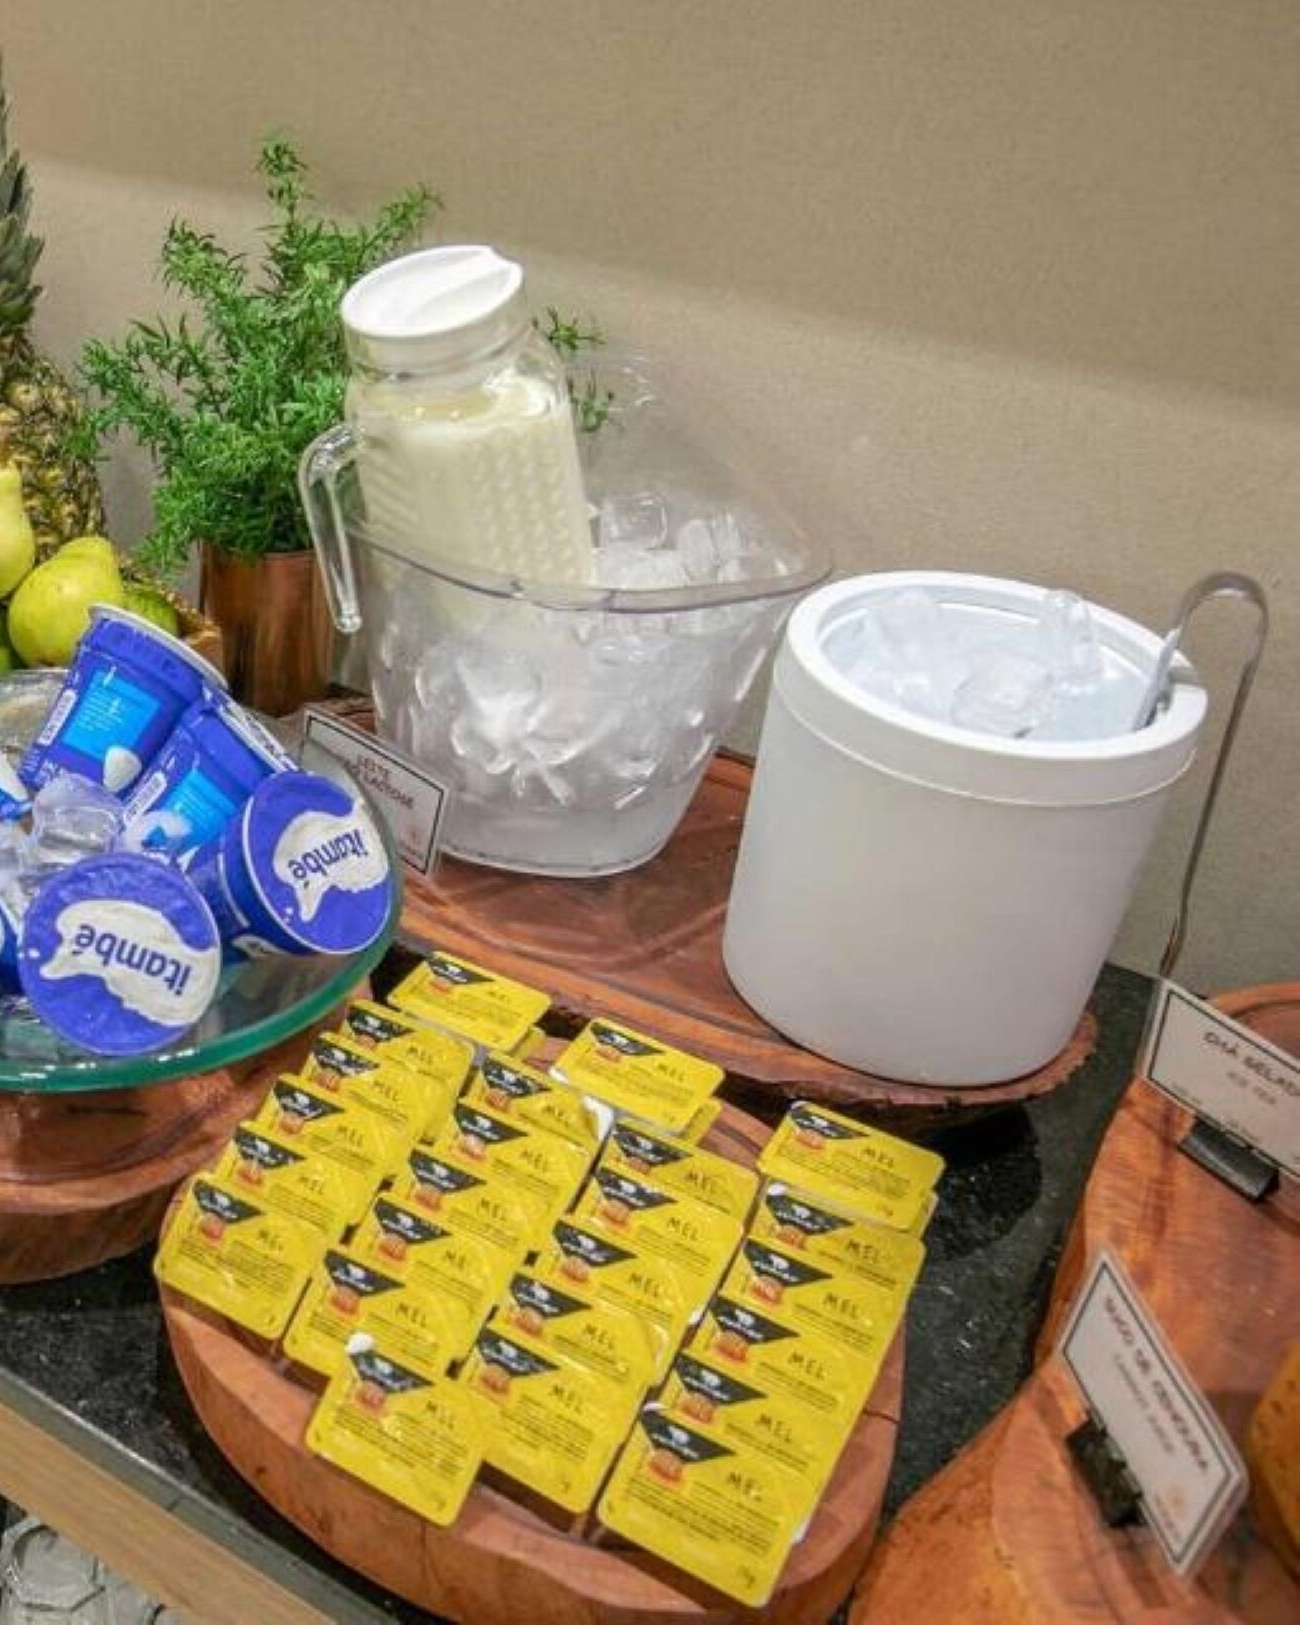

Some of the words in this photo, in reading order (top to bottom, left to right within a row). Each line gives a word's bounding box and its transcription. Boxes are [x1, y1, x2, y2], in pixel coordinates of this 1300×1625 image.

[288, 829, 368, 889] itambé
[74, 924, 192, 997] itambé
[860, 1145, 894, 1168] MEL
[667, 1216, 698, 1240] MEL
[845, 1238, 882, 1262] MEL
[628, 1272, 661, 1298] MEL
[395, 1302, 427, 1328] MEL
[823, 1292, 858, 1319] MEL
[789, 1351, 825, 1381] MEL
[550, 1384, 583, 1414] MEL
[755, 1412, 792, 1443] MEL
